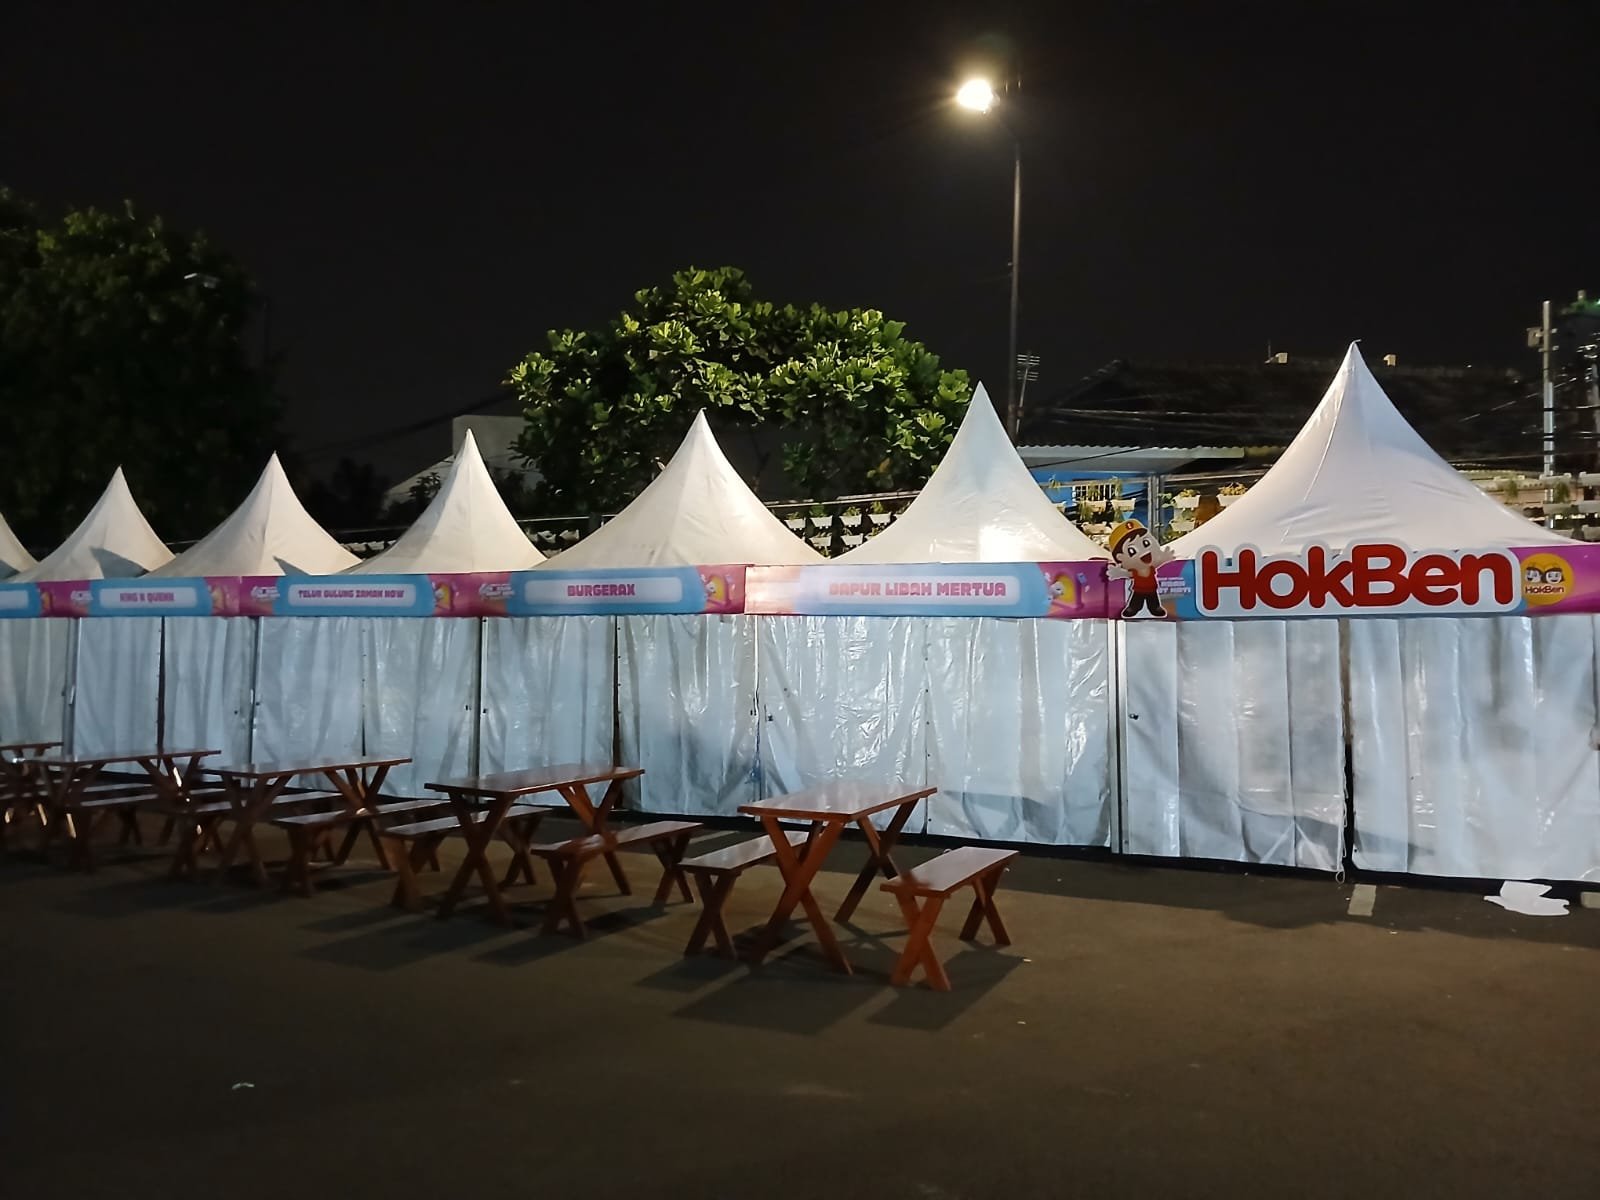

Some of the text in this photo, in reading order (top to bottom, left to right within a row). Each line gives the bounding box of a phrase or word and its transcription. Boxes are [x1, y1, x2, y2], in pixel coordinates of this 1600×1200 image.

[1201, 544, 1513, 610] HokBen
[384, 590, 404, 598] NOW
[829, 582, 1006, 596] DAPUR LIDAH MERTUA
[1525, 586, 1564, 594] HokBen
